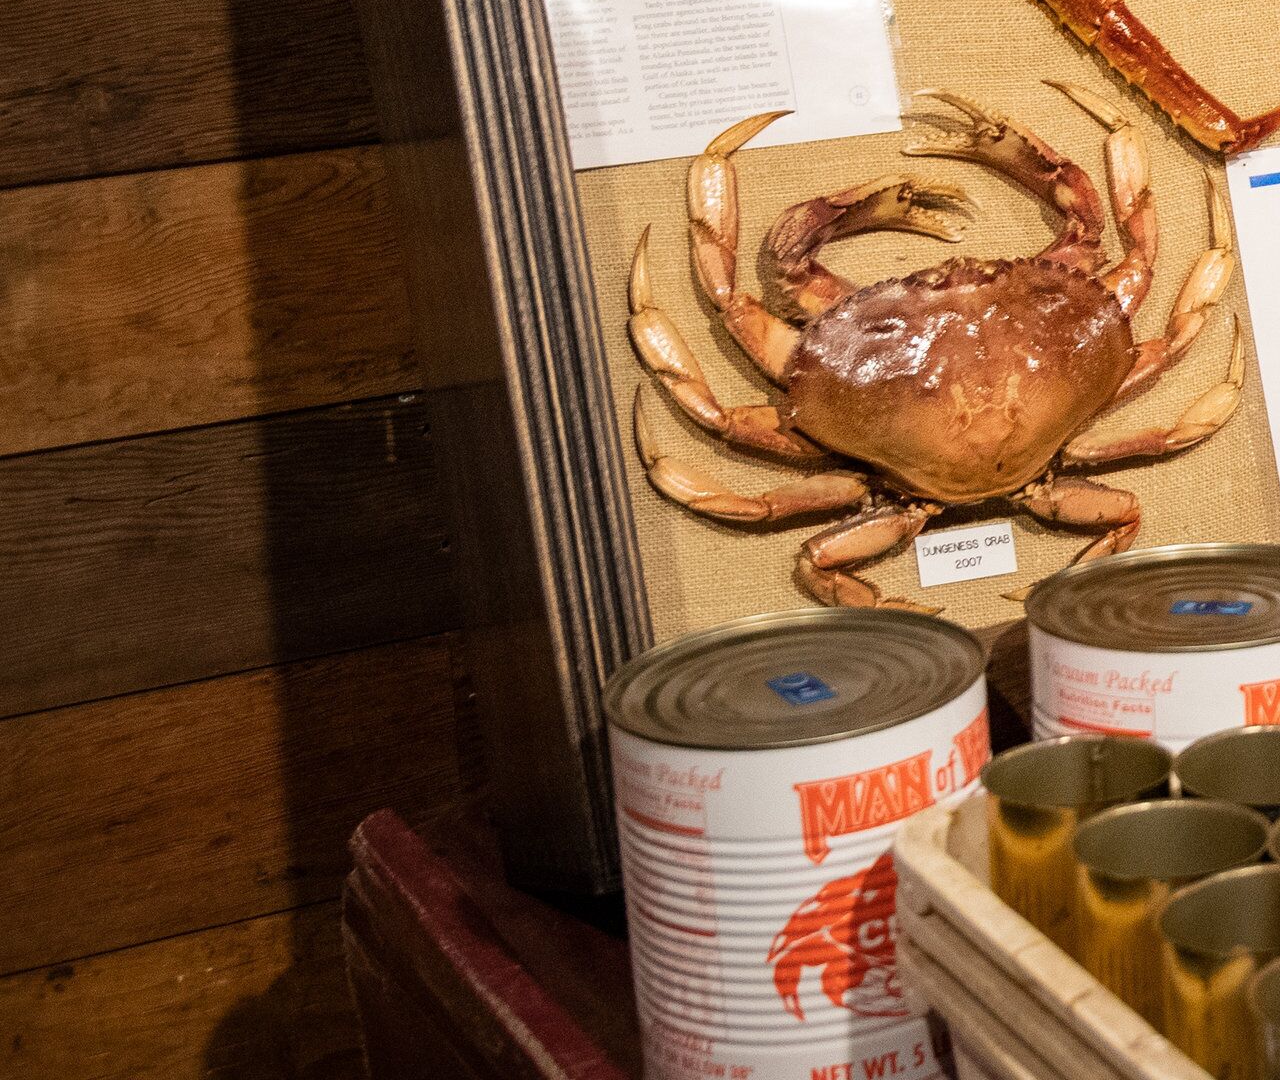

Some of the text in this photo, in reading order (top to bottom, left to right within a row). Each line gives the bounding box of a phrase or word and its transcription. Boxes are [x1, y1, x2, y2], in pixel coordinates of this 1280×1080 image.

[922, 534, 1011, 557] DUNGENESS CRAB
[955, 556, 982, 569] 2007
[1105, 669, 1179, 697] Packed
[793, 750, 958, 858] MAN of
